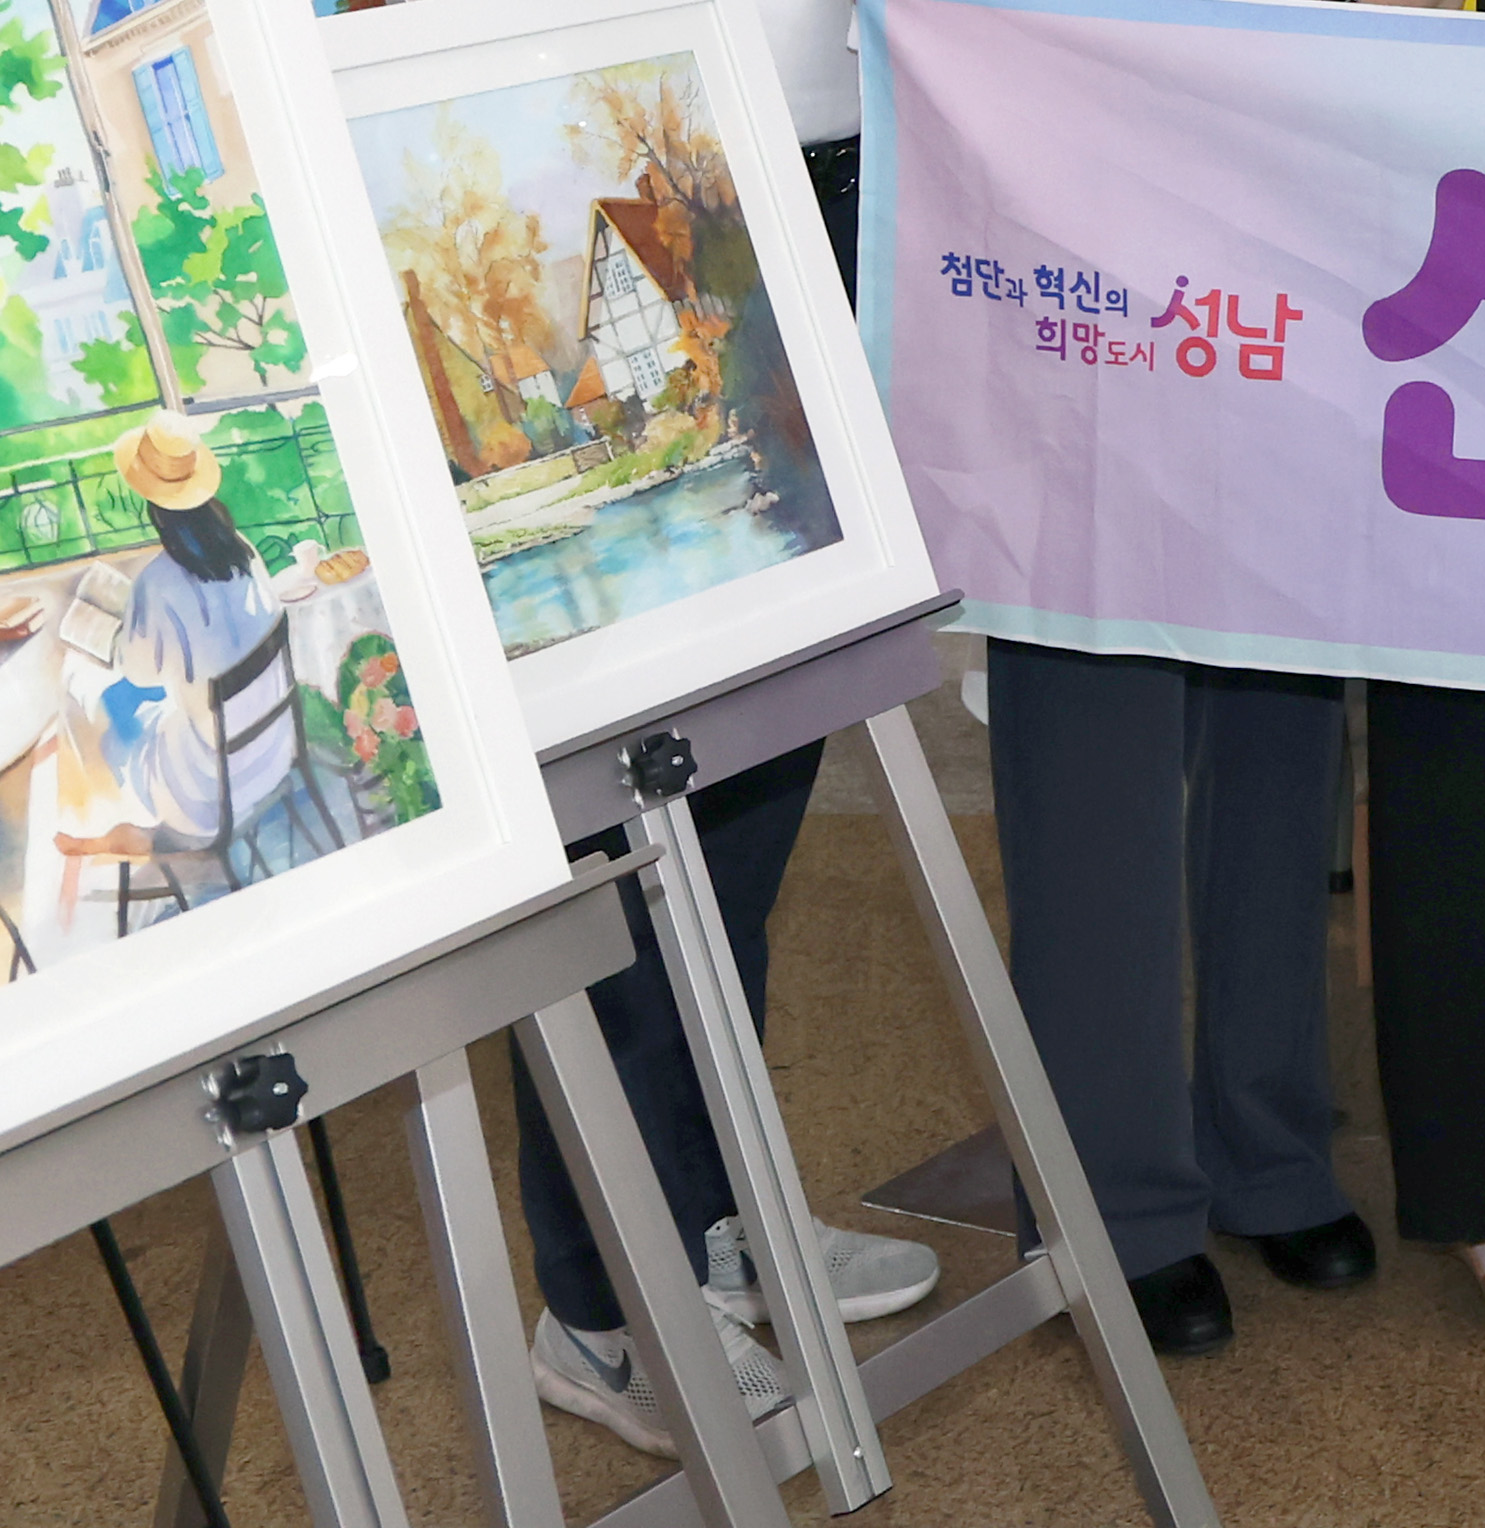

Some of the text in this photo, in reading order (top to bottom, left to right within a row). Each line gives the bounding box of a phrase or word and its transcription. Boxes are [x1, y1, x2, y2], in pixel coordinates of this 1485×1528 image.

[941, 252, 1129, 319] 첨단과 혁신의
[1034, 316, 1156, 372] 희망도시
[1151, 274, 1304, 381] 성남
